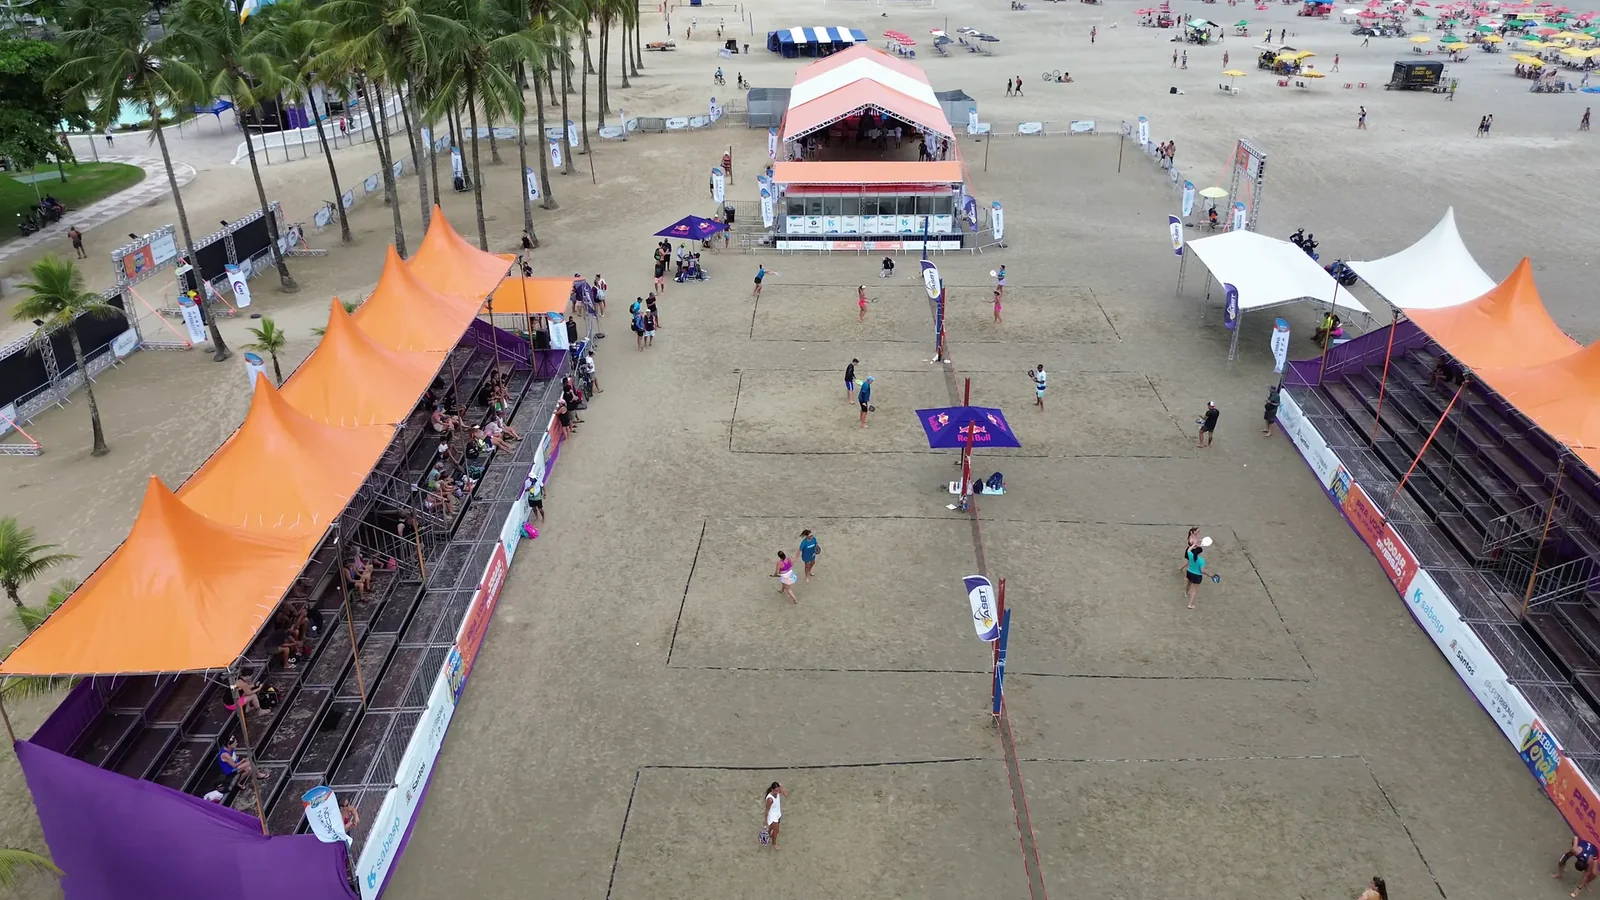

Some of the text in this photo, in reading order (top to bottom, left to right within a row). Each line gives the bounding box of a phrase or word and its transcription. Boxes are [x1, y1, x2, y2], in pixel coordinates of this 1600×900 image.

[957, 433, 991, 442] Re Bull
[1383, 537, 1406, 569] JOGAR
[979, 588, 990, 617] ASBT
[1421, 600, 1445, 634] sabesp
[1456, 650, 1475, 676] Santos
[1519, 723, 1557, 785] Verão
[1533, 724, 1560, 767] TRIBUNA
[412, 761, 426, 793] Santos
[1573, 787, 1596, 825] PRA
[376, 817, 400, 870] sabesp
